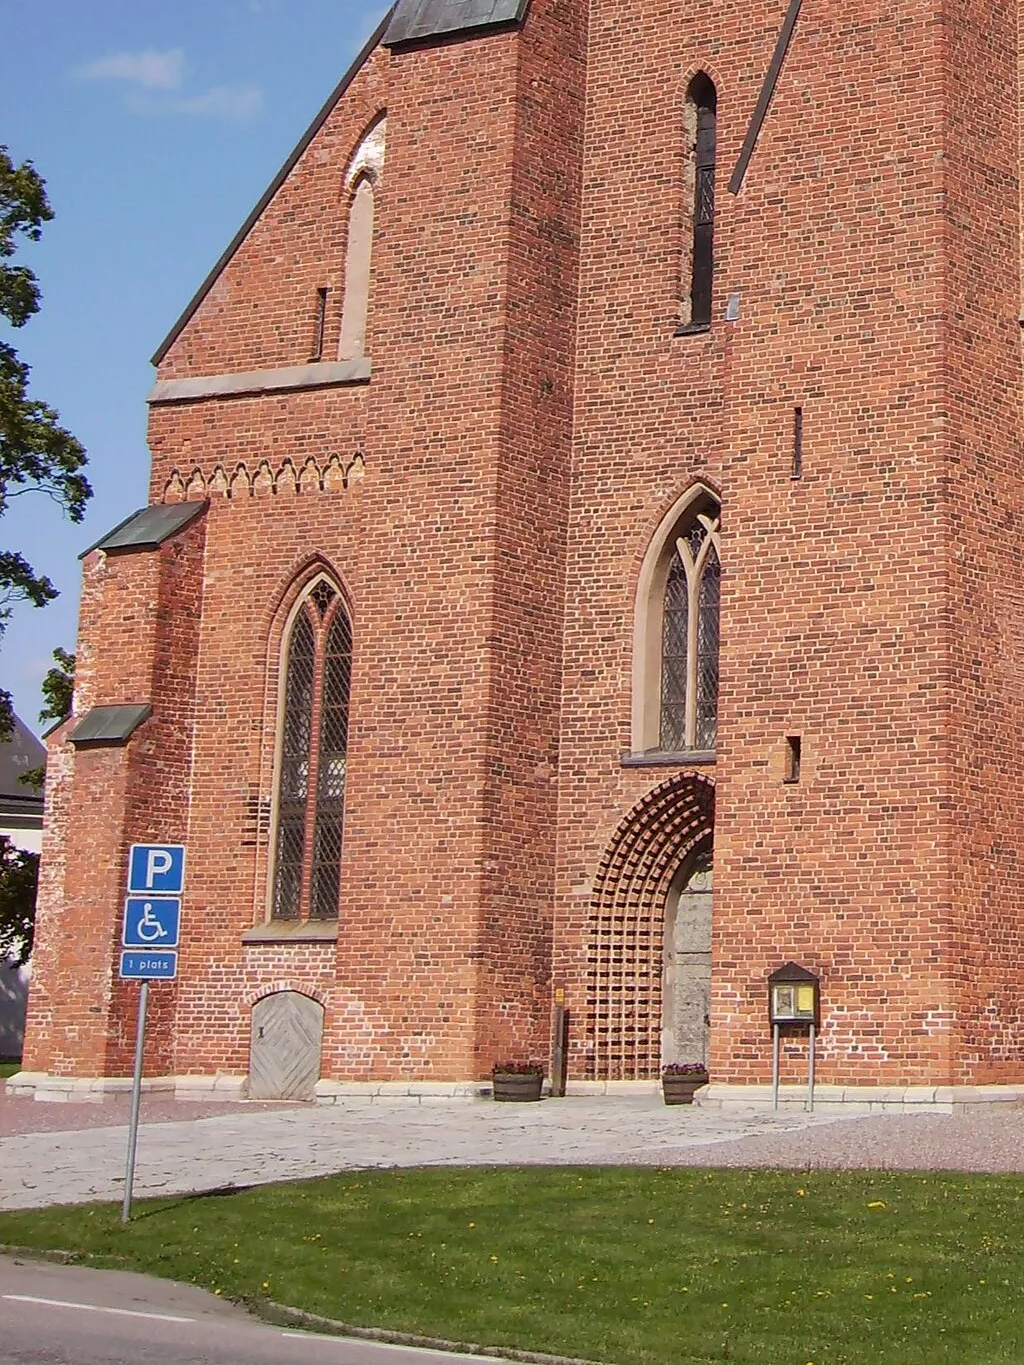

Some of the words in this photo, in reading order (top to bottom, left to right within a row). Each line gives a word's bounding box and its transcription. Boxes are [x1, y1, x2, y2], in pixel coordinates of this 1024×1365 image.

[146, 849, 173, 888] P
[129, 959, 134, 969] 1
[139, 959, 169, 971] plats
